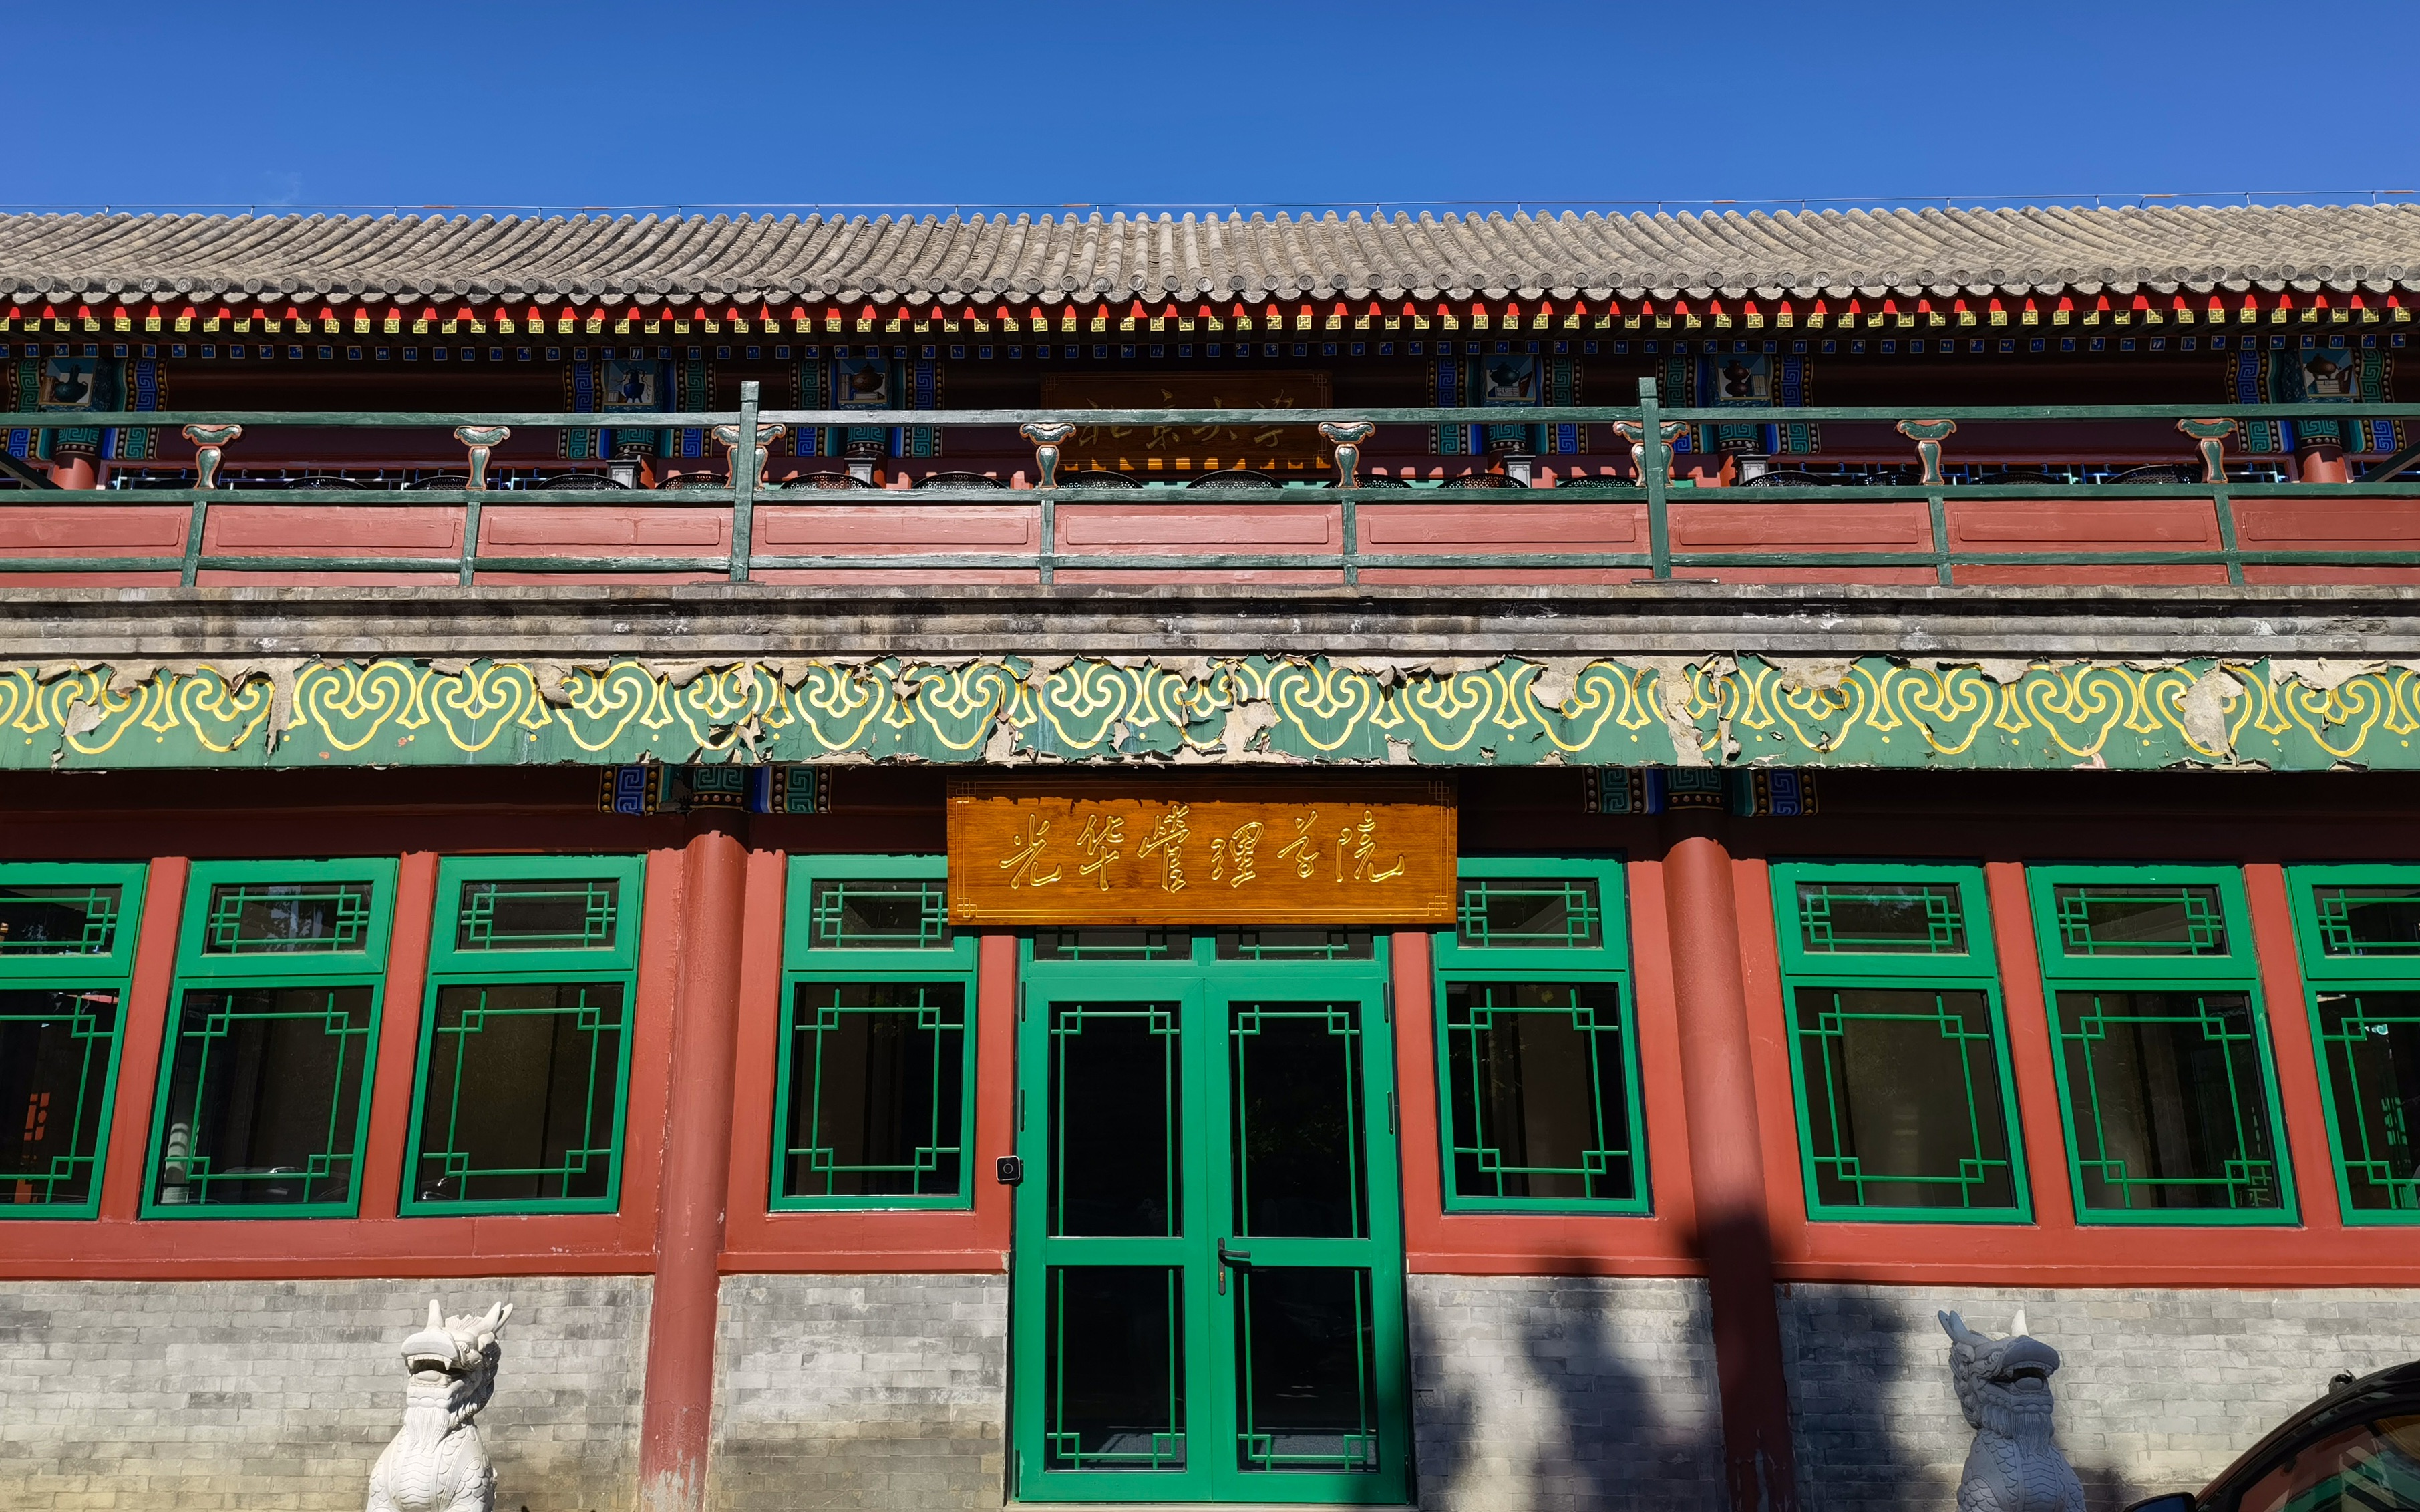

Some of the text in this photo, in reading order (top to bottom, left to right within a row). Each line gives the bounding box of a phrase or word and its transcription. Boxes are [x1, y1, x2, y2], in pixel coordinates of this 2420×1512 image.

[1000, 804, 1405, 893] 光华管理学院
